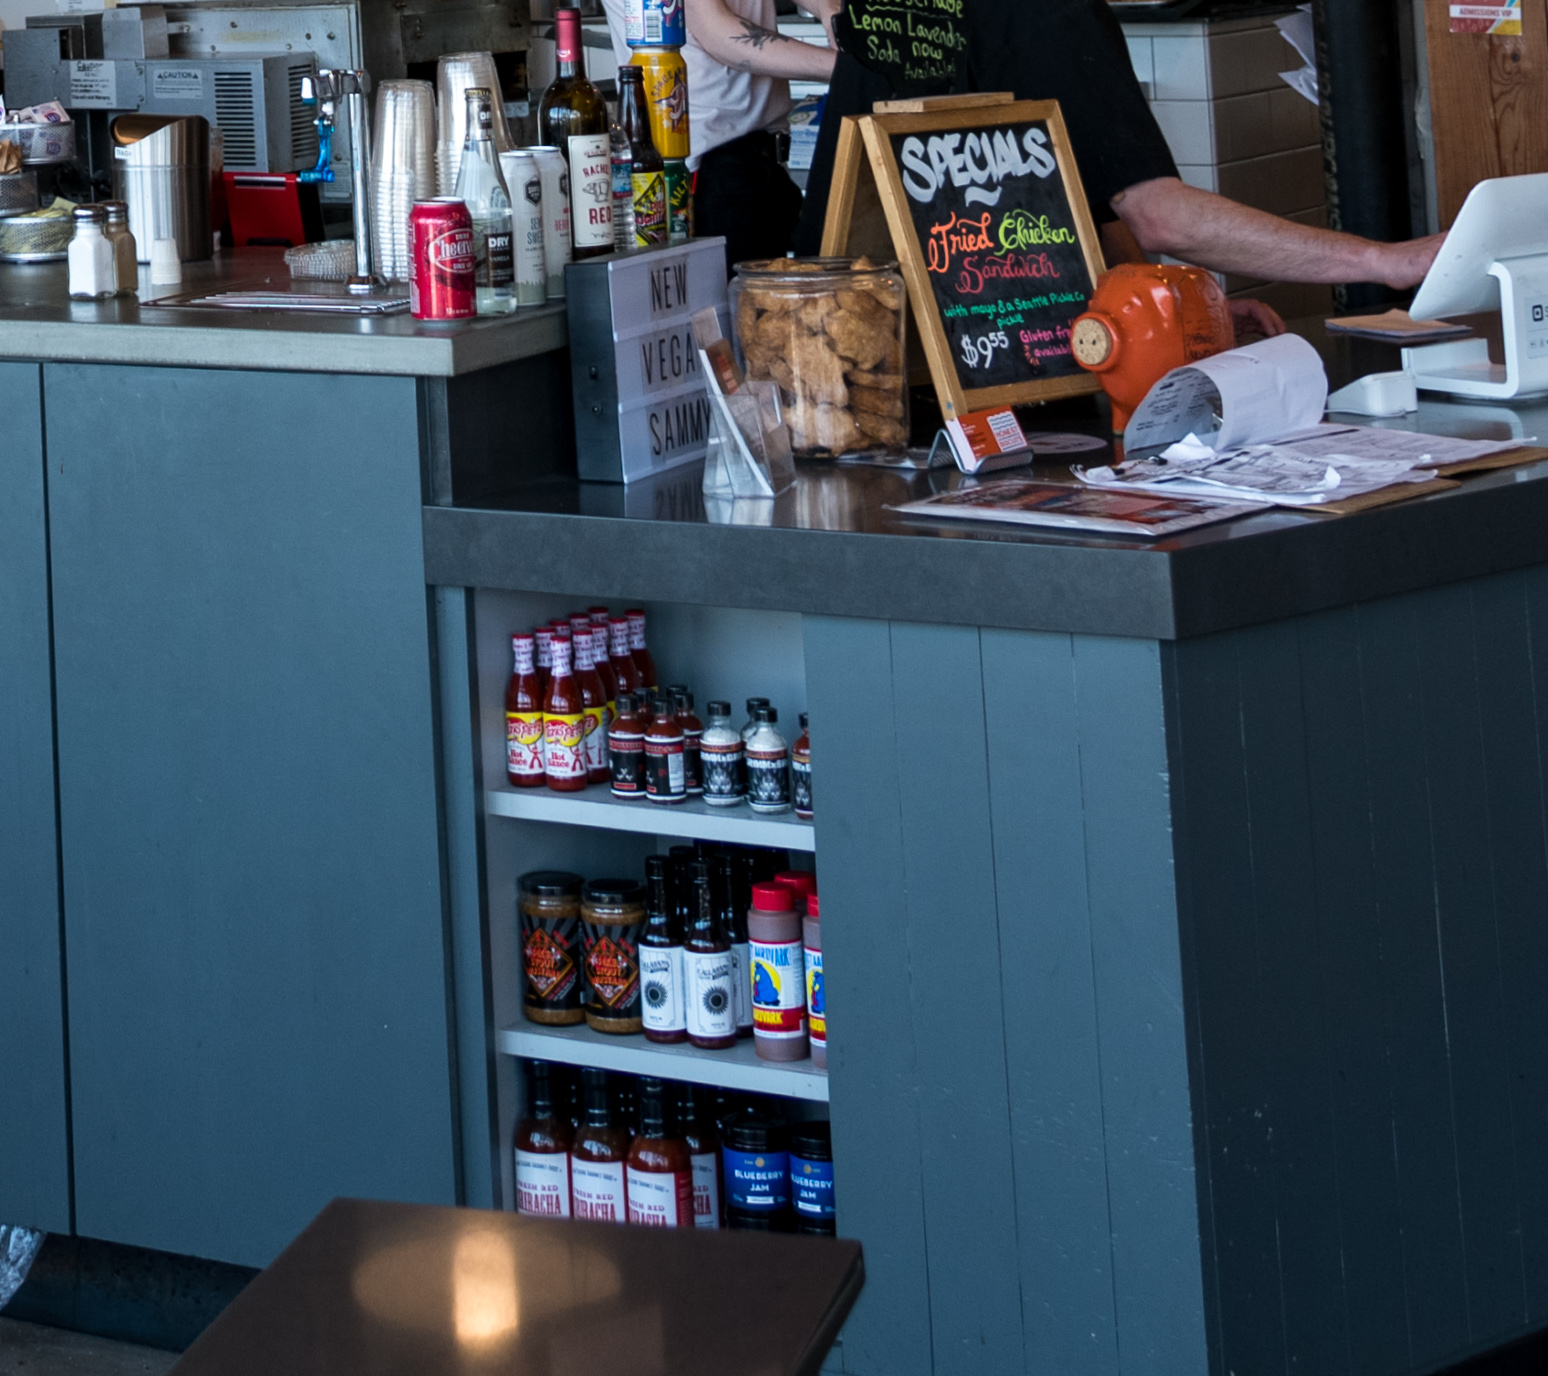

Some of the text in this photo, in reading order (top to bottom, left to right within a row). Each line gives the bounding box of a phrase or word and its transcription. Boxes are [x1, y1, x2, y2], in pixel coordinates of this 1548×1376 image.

[849, 4, 902, 35] Lemon
[867, 35, 901, 63] Soda
[912, 41, 943, 60] now
[163, 71, 193, 79] CAUTION
[901, 127, 1056, 203] SPECIALS
[589, 207, 612, 225] RED
[488, 236, 510, 248] DRY
[927, 209, 1075, 273] Fried Chicken
[955, 252, 1060, 294] Sandwich
[651, 263, 686, 312] NEW
[944, 304, 968, 318] with
[970, 303, 996, 320] mayo
[1014, 294, 1049, 310] Seattle
[1019, 328, 1053, 343] Gluten
[643, 332, 696, 385] VEGA
[510, 749, 523, 758] Hot
[551, 752, 565, 760] Hot
[734, 1170, 783, 1180] BLUEBERRY
[750, 1183, 769, 1192] JAM
[800, 1189, 816, 1199] JAM
